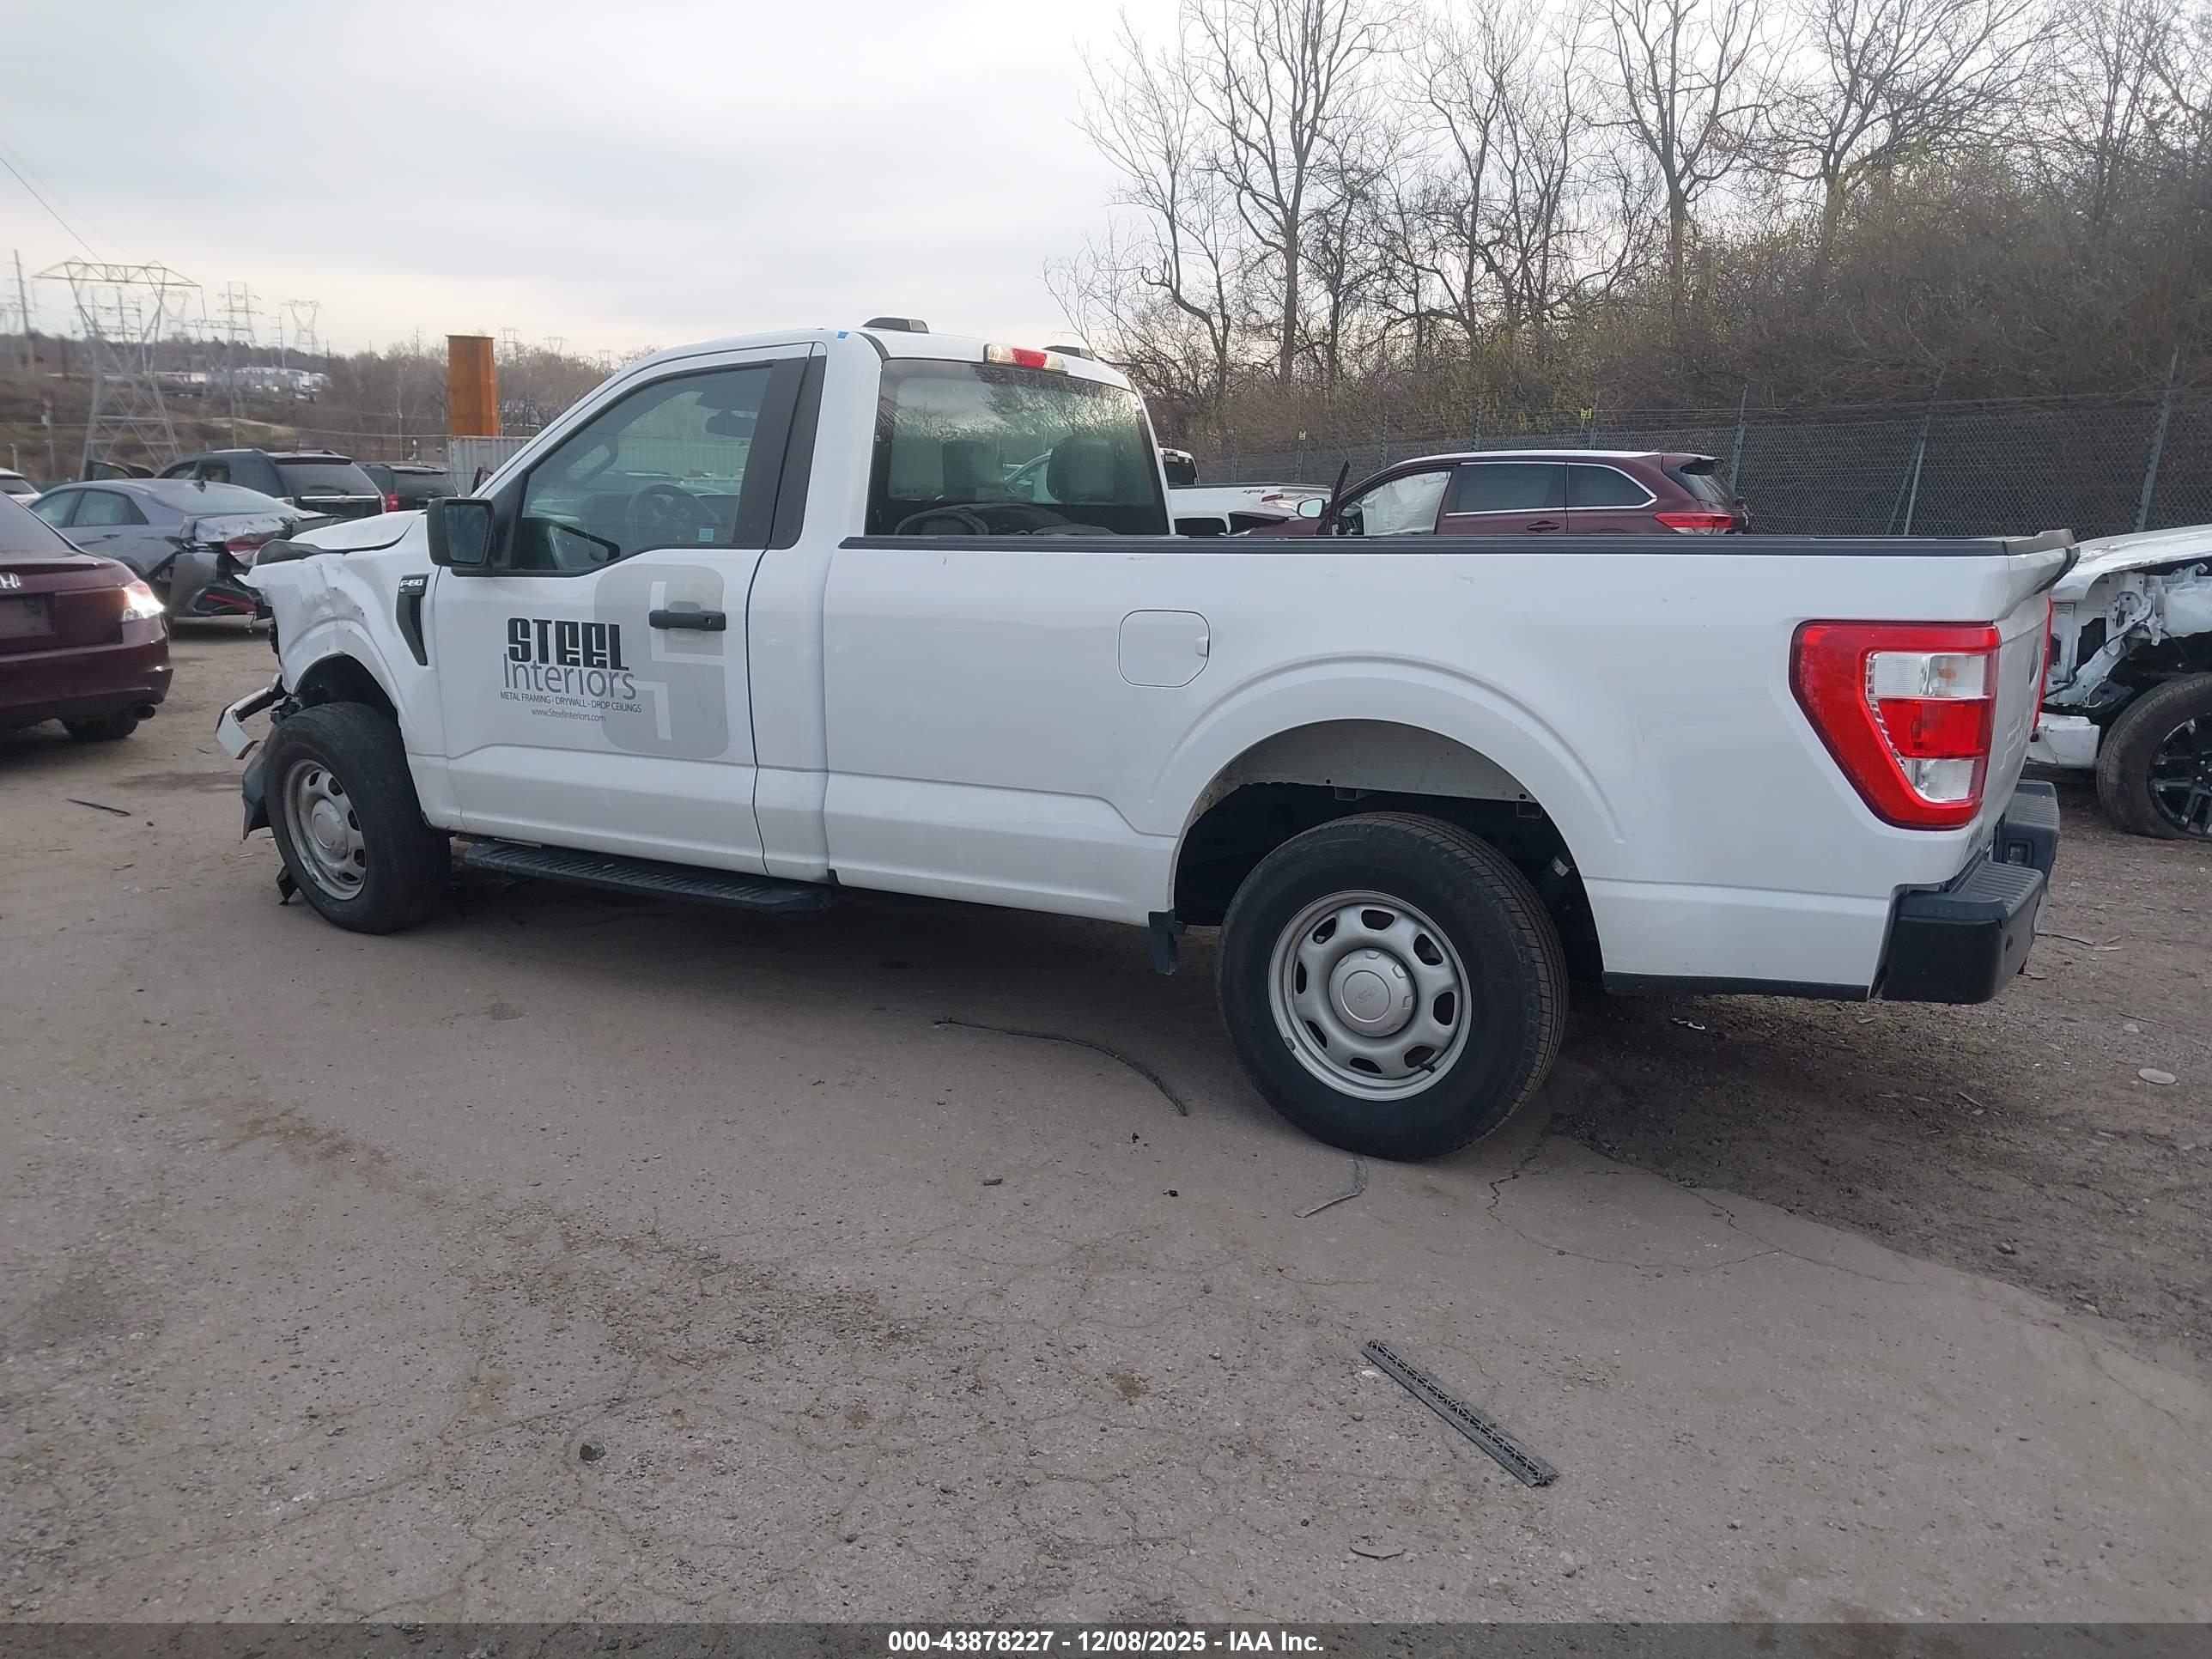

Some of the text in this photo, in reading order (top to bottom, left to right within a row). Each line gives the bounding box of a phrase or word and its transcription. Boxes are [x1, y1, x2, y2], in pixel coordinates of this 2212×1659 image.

[507, 617, 629, 671] STEEL
[503, 653, 637, 700] Interiors
[500, 691, 521, 702] METAL
[521, 694, 551, 704] FRAMING
[556, 697, 587, 708] DRYWALL
[592, 700, 611, 710] DROP
[611, 702, 641, 713] CEILINGS
